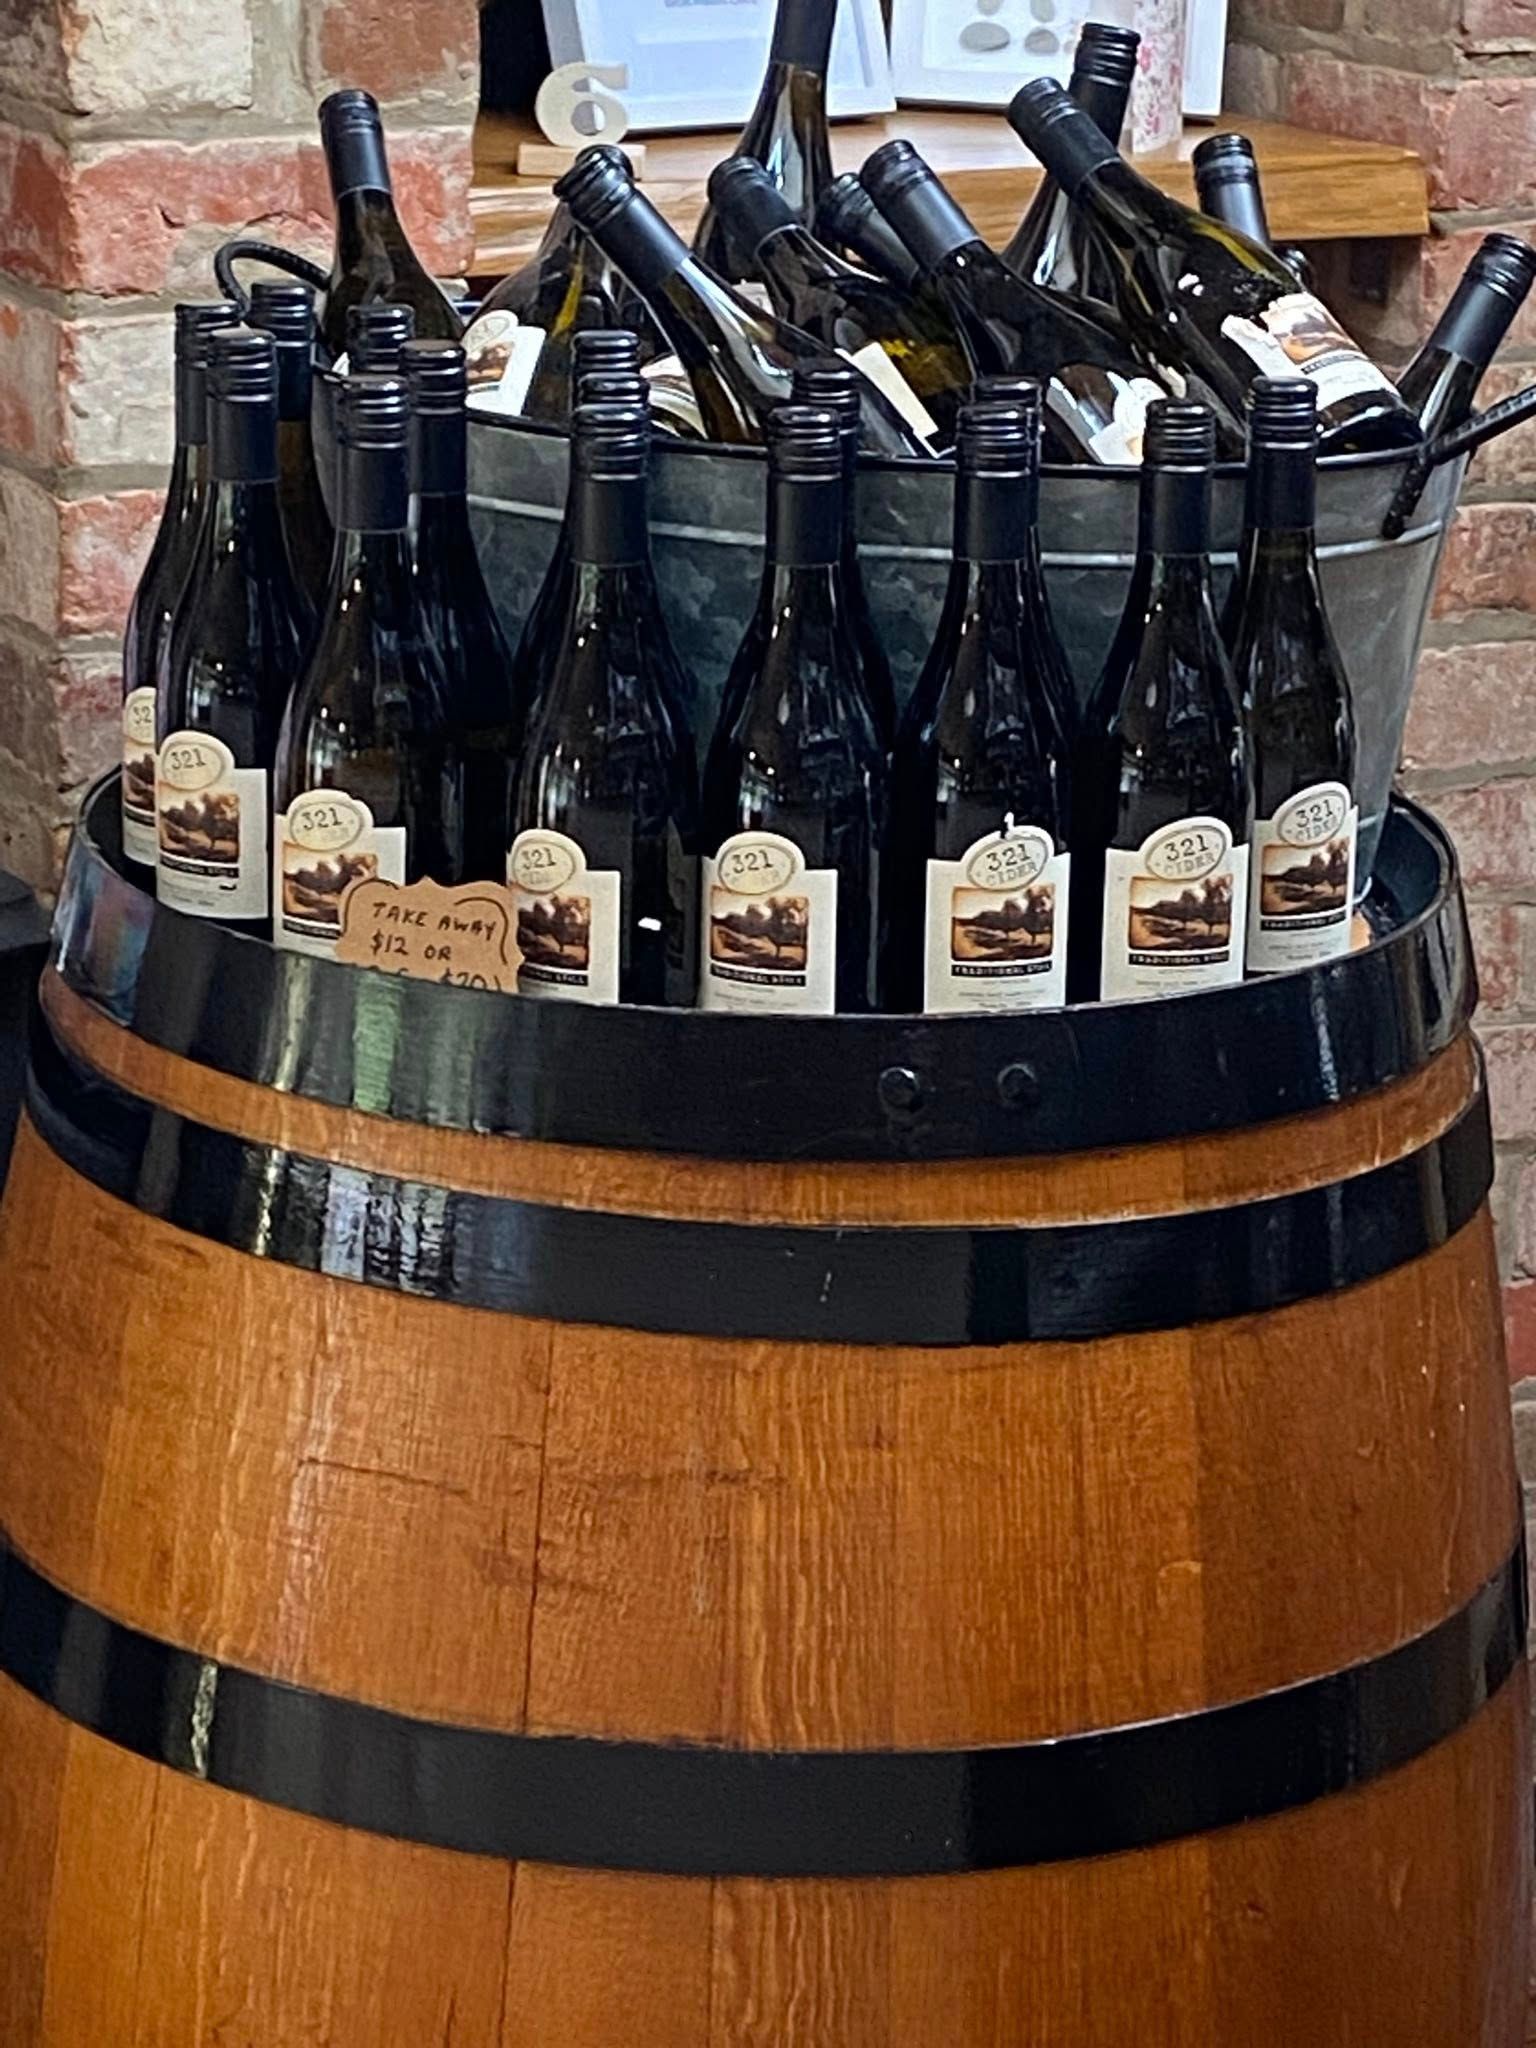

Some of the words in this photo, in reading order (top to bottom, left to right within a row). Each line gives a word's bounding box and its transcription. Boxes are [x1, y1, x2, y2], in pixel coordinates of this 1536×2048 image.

[535, 61, 628, 148] 6
[133, 704, 154, 725] 32
[171, 748, 206, 770] 321
[302, 807, 342, 830] 321
[1295, 799, 1333, 828] 321
[521, 847, 557, 870] 321
[986, 843, 1031, 871] 321
[1165, 834, 1209, 861] 321
[731, 850, 773, 874] 321
[986, 862, 1037, 886] CIDER
[1164, 852, 1215, 876] CIDER
[372, 902, 428, 927] TAKE
[437, 915, 497, 941] AWAY
[370, 928, 409, 956] $12
[424, 944, 452, 961] OR
